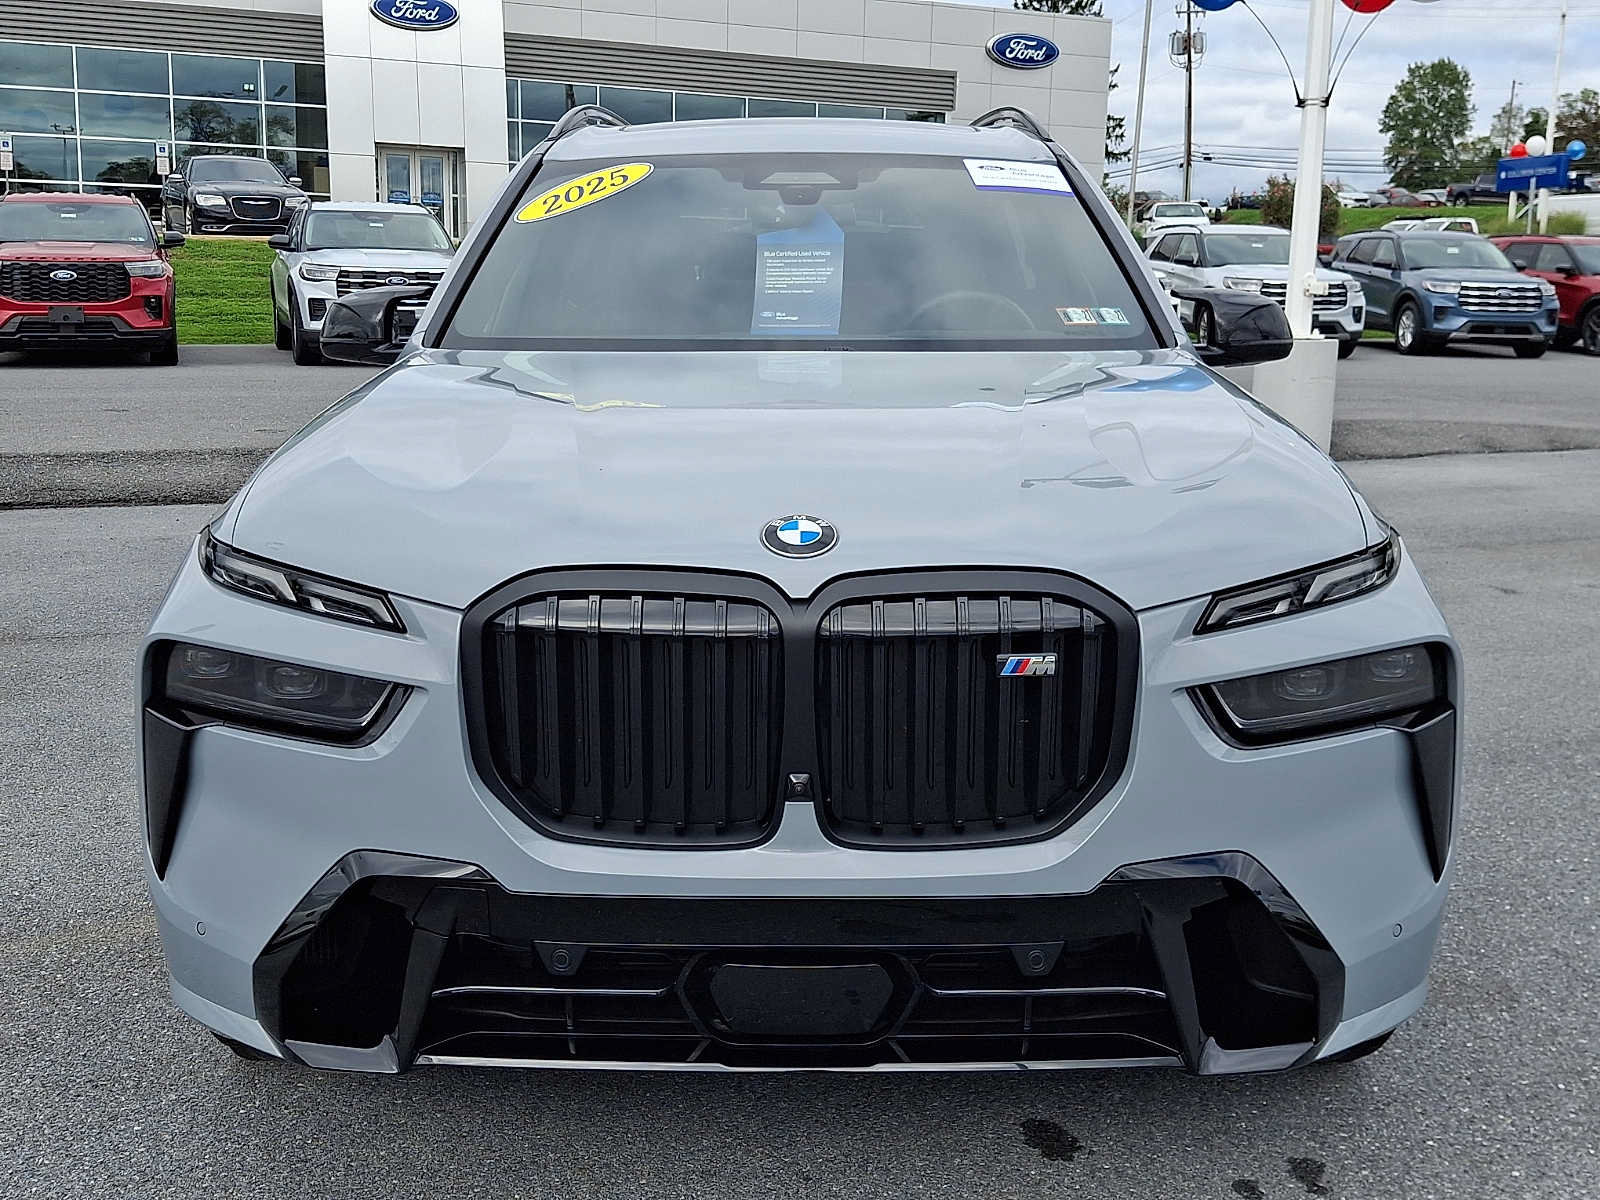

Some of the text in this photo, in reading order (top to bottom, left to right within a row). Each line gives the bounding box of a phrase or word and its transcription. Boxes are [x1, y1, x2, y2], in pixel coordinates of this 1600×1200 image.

[391, 0, 440, 20] Ford
[1005, 39, 1047, 60] Ford
[542, 168, 629, 214] 2025
[770, 514, 831, 527] BMW
